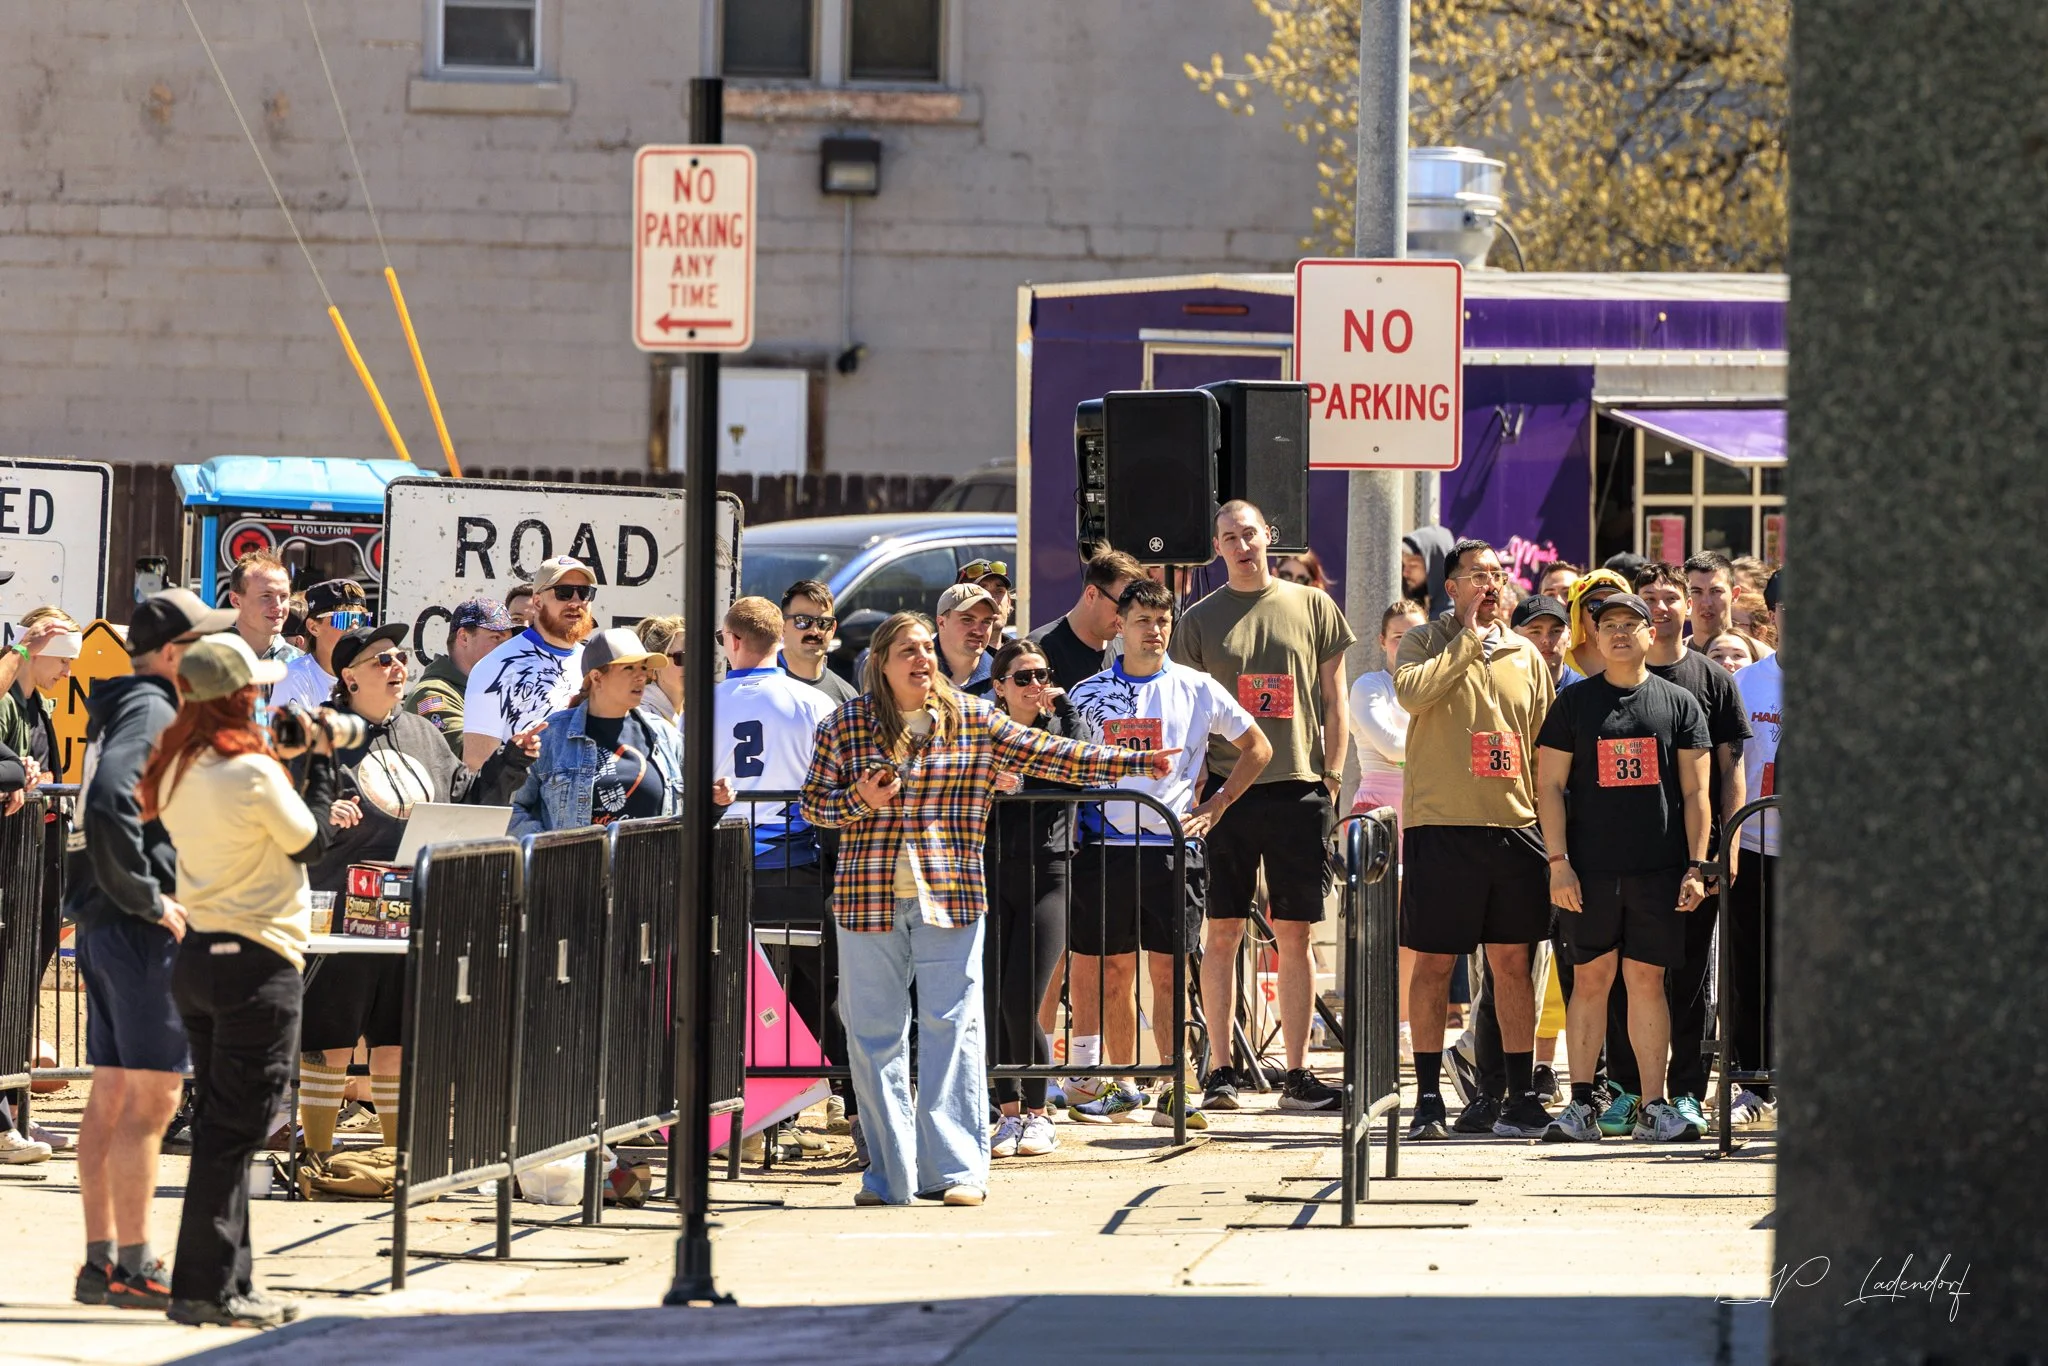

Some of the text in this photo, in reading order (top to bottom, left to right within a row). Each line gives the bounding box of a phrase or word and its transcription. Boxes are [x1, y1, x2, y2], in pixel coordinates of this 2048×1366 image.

[674, 168, 715, 203] NO
[644, 213, 743, 248] PARKING
[671, 253, 716, 278] ANY
[668, 284, 718, 308] TIME
[1343, 308, 1414, 354] NO
[1309, 382, 1450, 422] PARKING
[292, 525, 351, 536] EVOLUTION
[455, 515, 659, 588] ROAD
[1259, 693, 1272, 712] 2
[733, 720, 764, 778] 2
[1490, 749, 1511, 771] 35
[1616, 758, 1642, 780] 33
